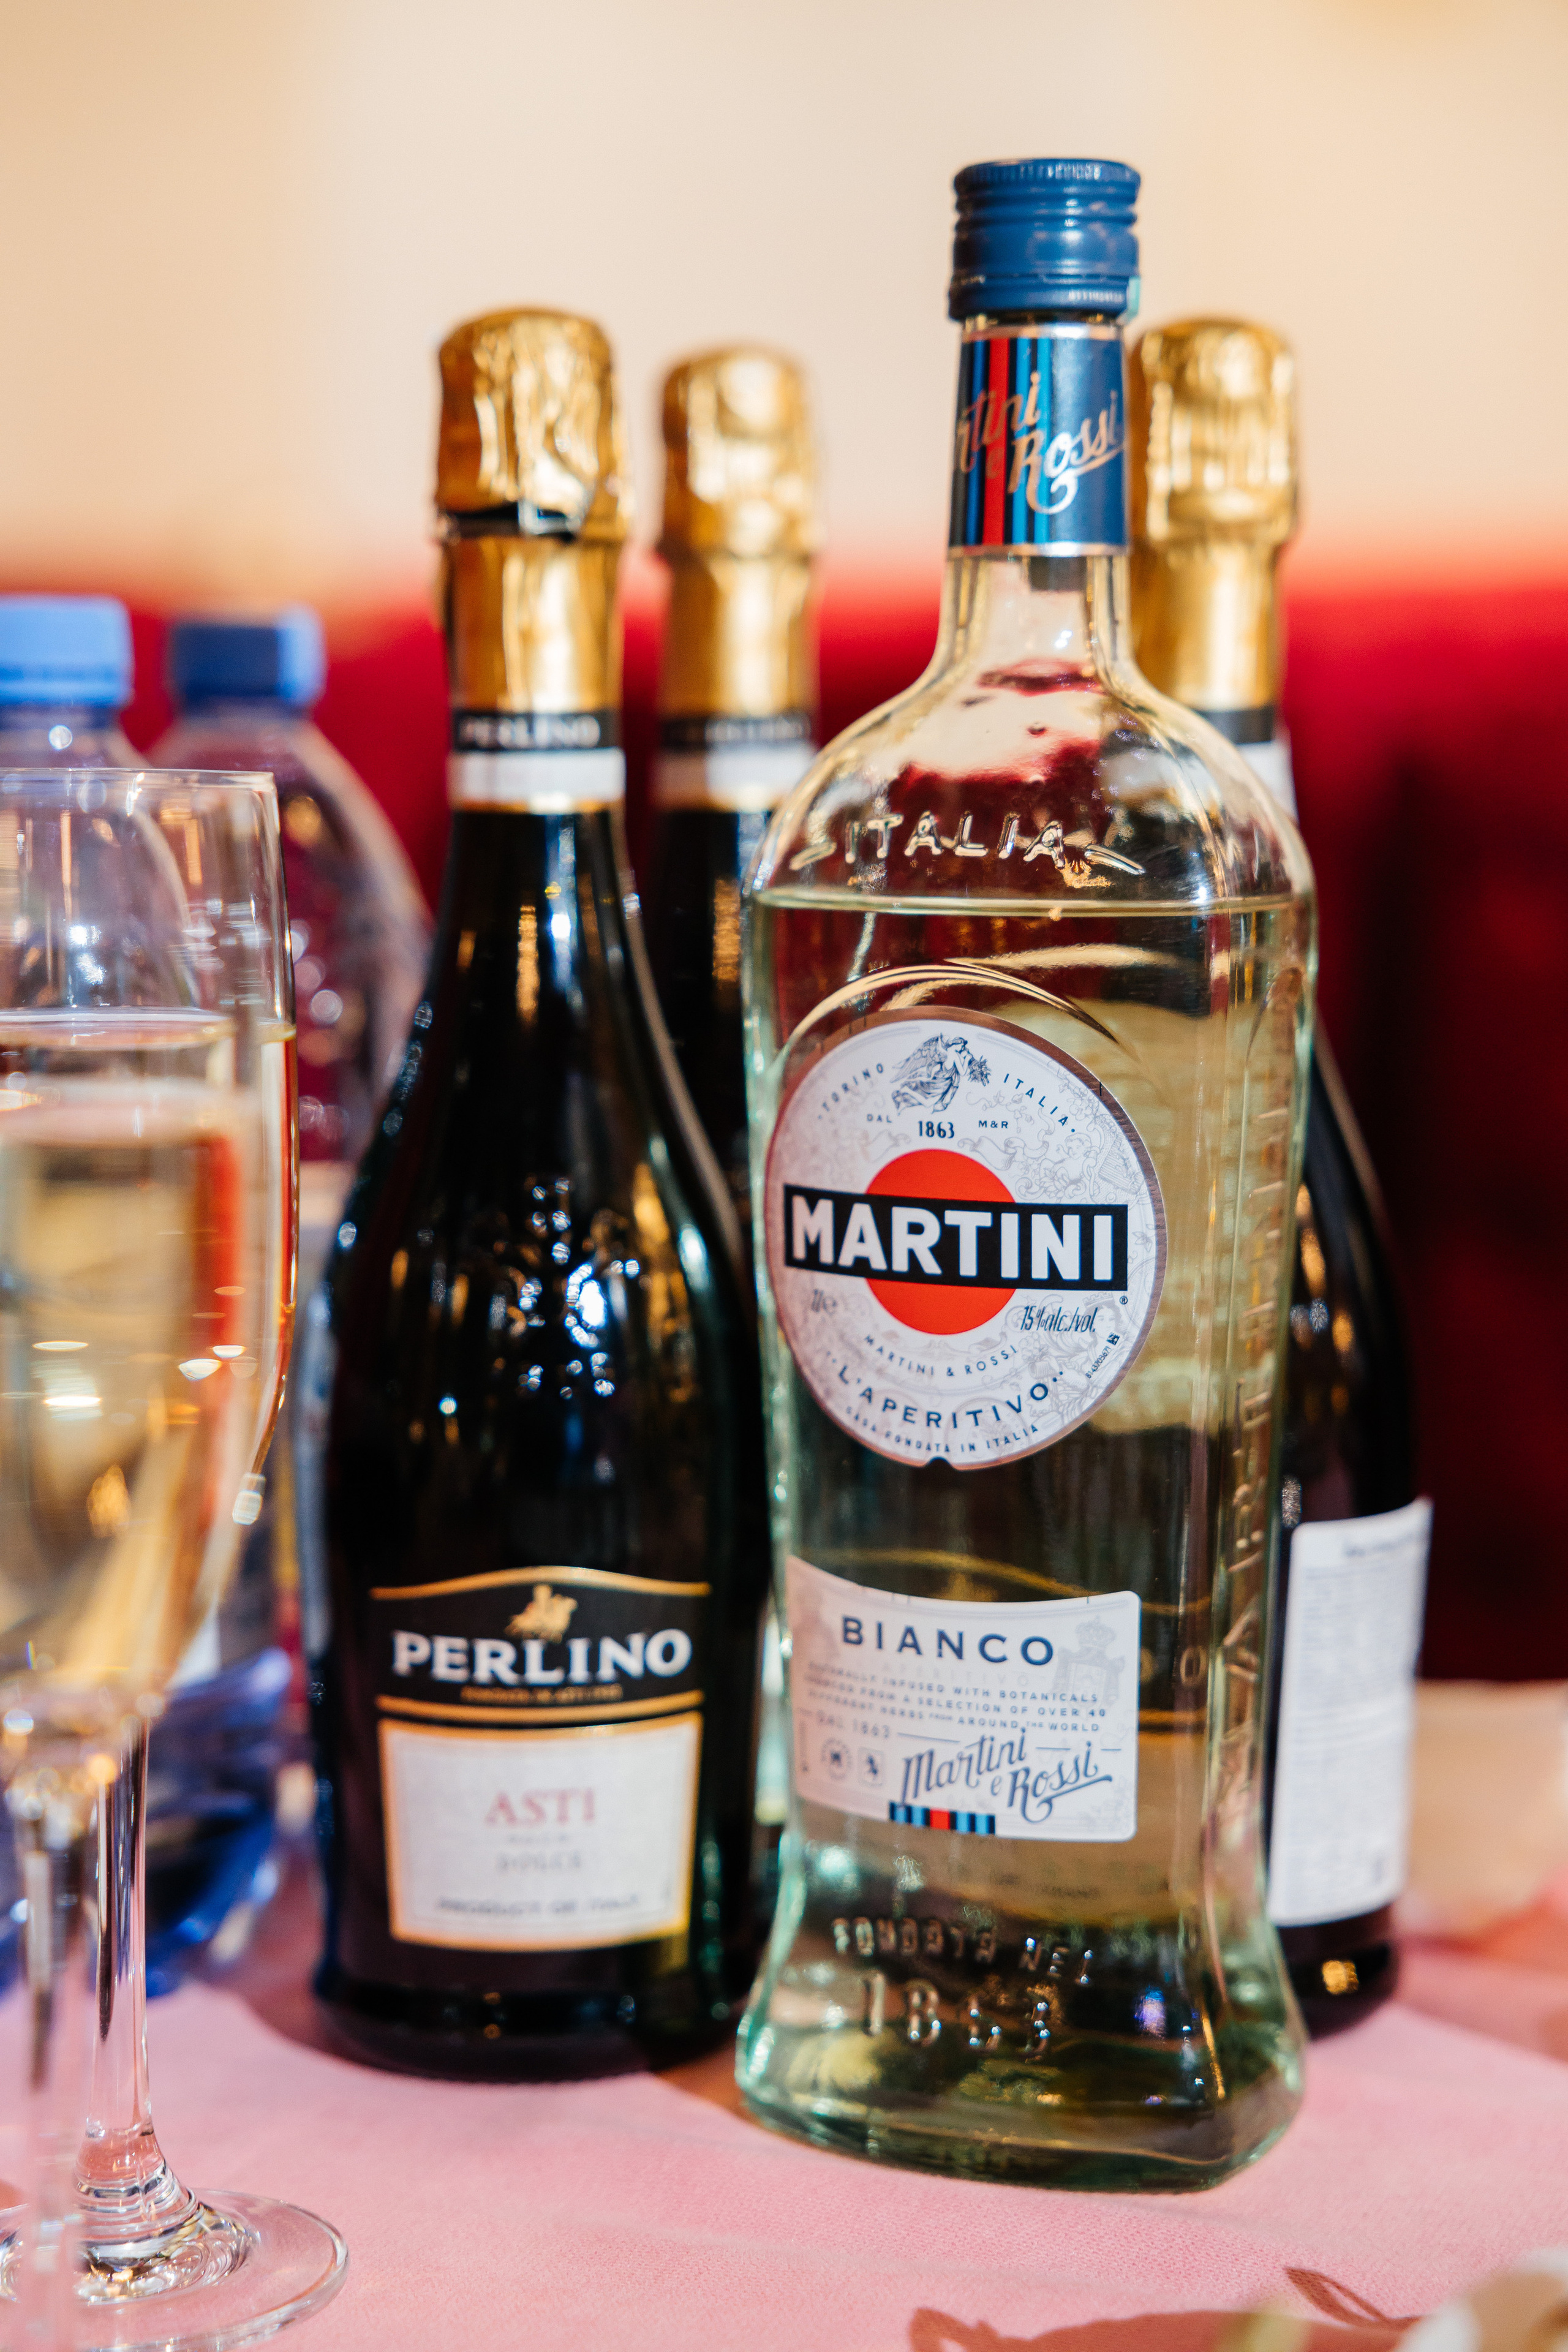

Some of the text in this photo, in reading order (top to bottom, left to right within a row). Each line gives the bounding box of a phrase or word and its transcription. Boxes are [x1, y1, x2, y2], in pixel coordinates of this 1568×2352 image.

[844, 811, 1066, 869] ITALIA
[821, 1063, 884, 1112] TORINO
[866, 1114, 892, 1123] DAL
[918, 1120, 955, 1139] 1863
[791, 1195, 1114, 1281] MARTINI
[864, 1335, 1017, 1377] MARTINI & ROSSI
[886, 1431, 951, 1453] FONDATA
[961, 1443, 976, 1452] IN
[987, 1424, 1039, 1449] ITALIA
[391, 1629, 692, 1686] PERLINO
[842, 1615, 1054, 1666] BIANCO
[883, 1677, 944, 1693] INFUSED
[953, 1686, 990, 1697] WITH
[1000, 1691, 1098, 1702] BOTANICALS
[919, 1697, 1001, 1713] SELECTION
[1010, 1705, 1028, 1714] OF
[1038, 1707, 1080, 1716] OVER
[1088, 1708, 1107, 1717] 40
[958, 1716, 1019, 1728] AROUND
[1049, 1722, 1100, 1732] WORLD
[902, 1727, 1027, 1805] Martini
[1008, 1741, 1113, 1824] Rossi
[484, 1787, 597, 1825] ASTI
